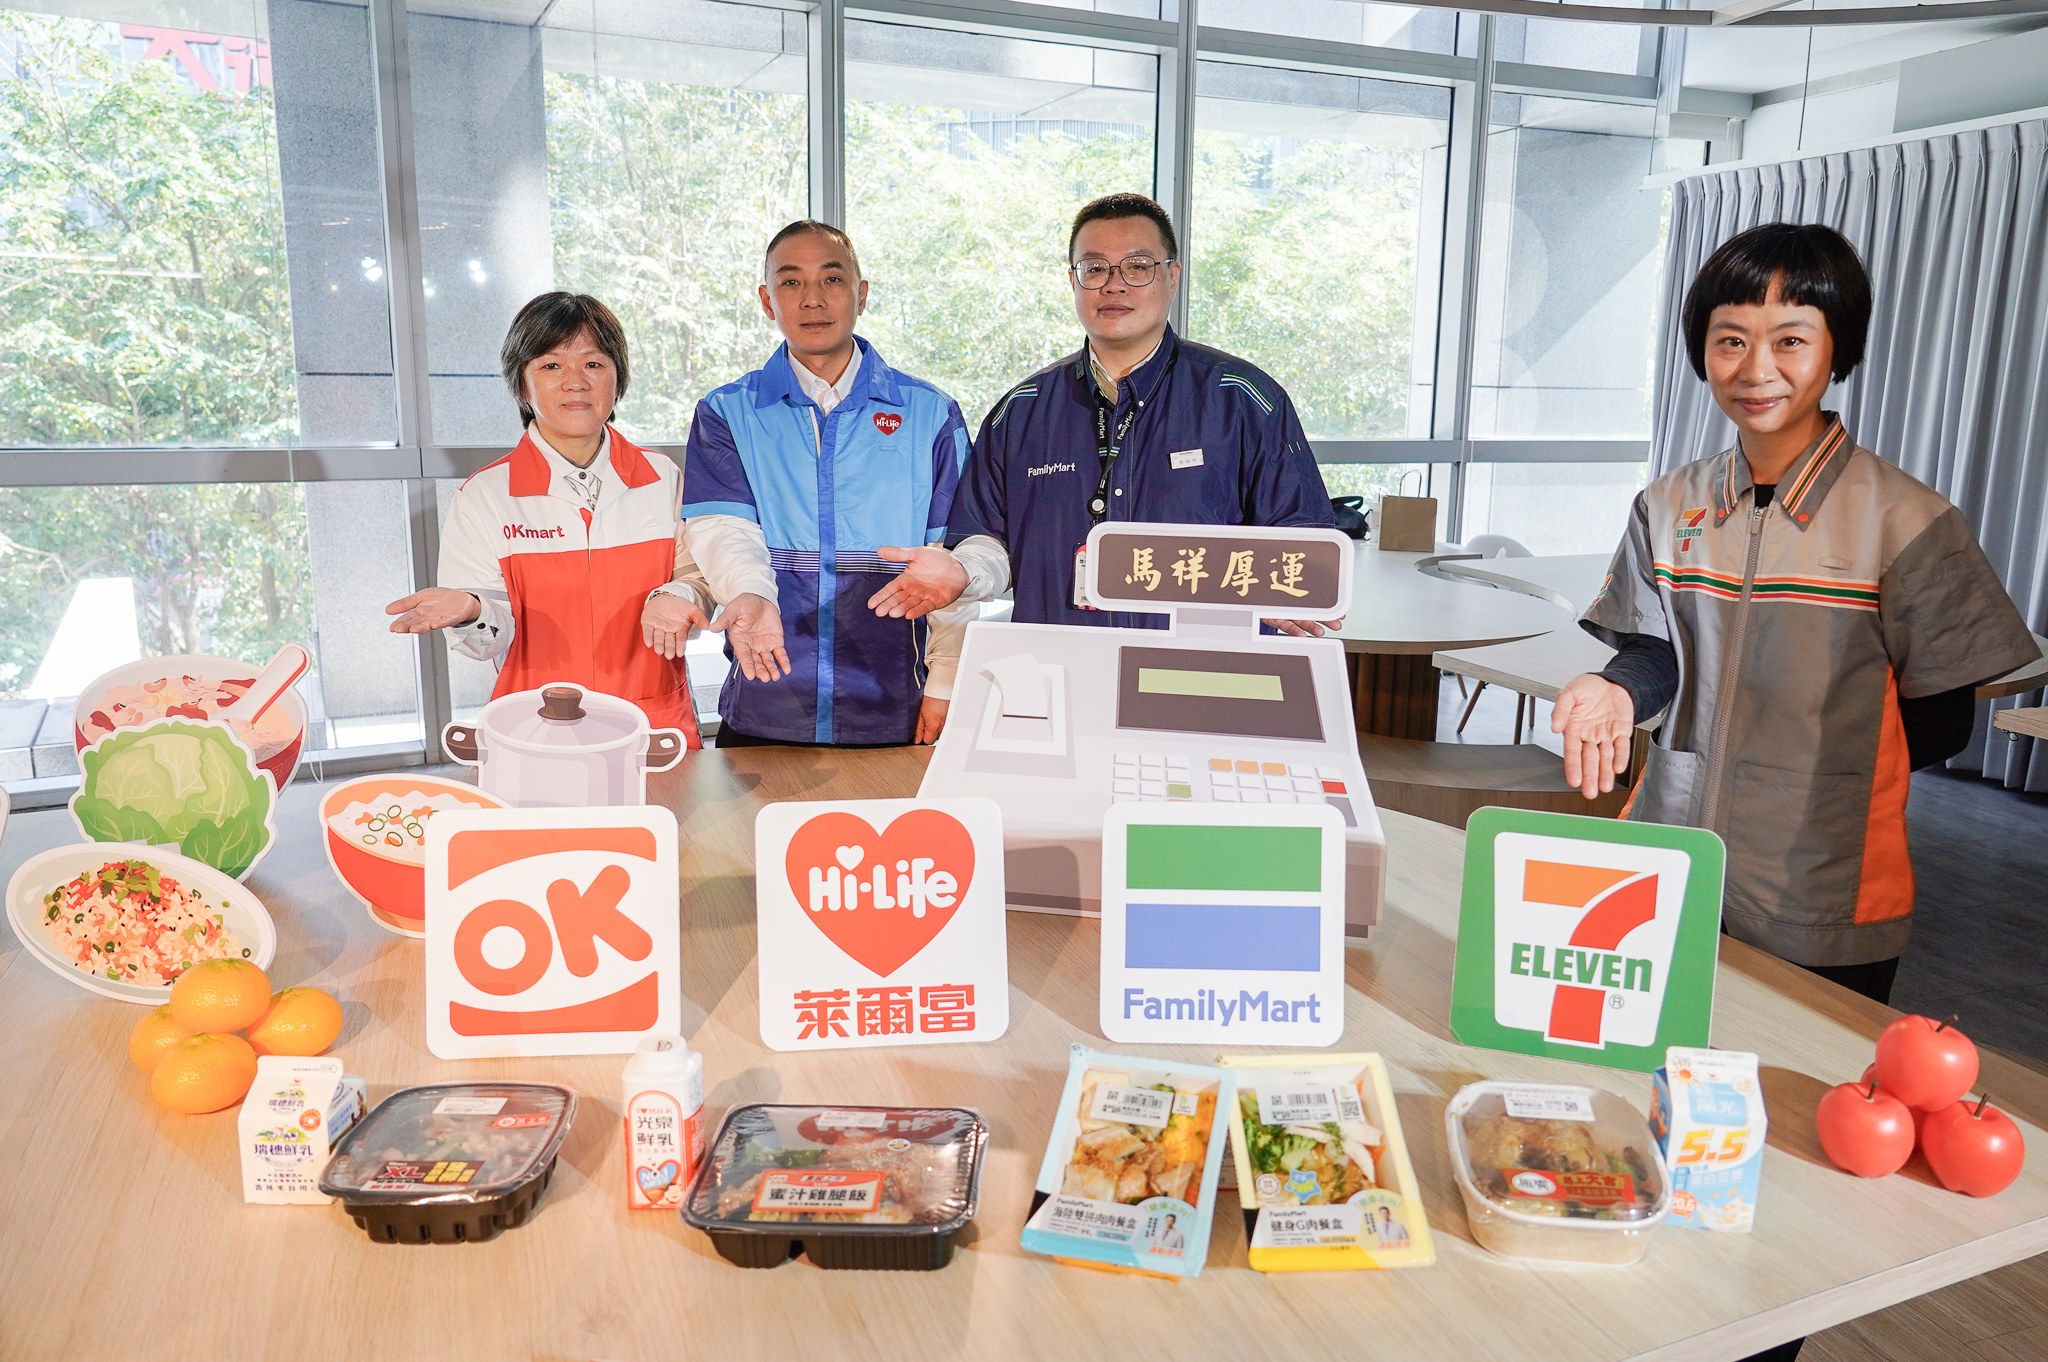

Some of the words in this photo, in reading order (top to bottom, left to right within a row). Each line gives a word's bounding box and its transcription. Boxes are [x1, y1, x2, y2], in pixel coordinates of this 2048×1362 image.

[1117, 411, 1134, 440] FamilyMart
[1027, 462, 1076, 478] FamilyMart
[503, 524, 565, 540] OKmart
[1124, 547, 1310, 598] 馬祥厚運
[809, 845, 958, 918] Hi-Life
[454, 865, 653, 996] OK
[793, 983, 976, 1040] 萊爾富
[1124, 988, 1321, 1027] FamilyMart
[637, 1116, 673, 1129] 光泉
[637, 1133, 675, 1146] 鮮乳
[1676, 1128, 1749, 1164] 5.5
[254, 1144, 313, 1156] 瑞穗鮮乳
[379, 1166, 425, 1178] XL
[769, 1188, 868, 1202] 蜜汁雞腿飯
[1057, 1197, 1094, 1209] FamilyMart
[1269, 1210, 1307, 1218] FamilyMart
